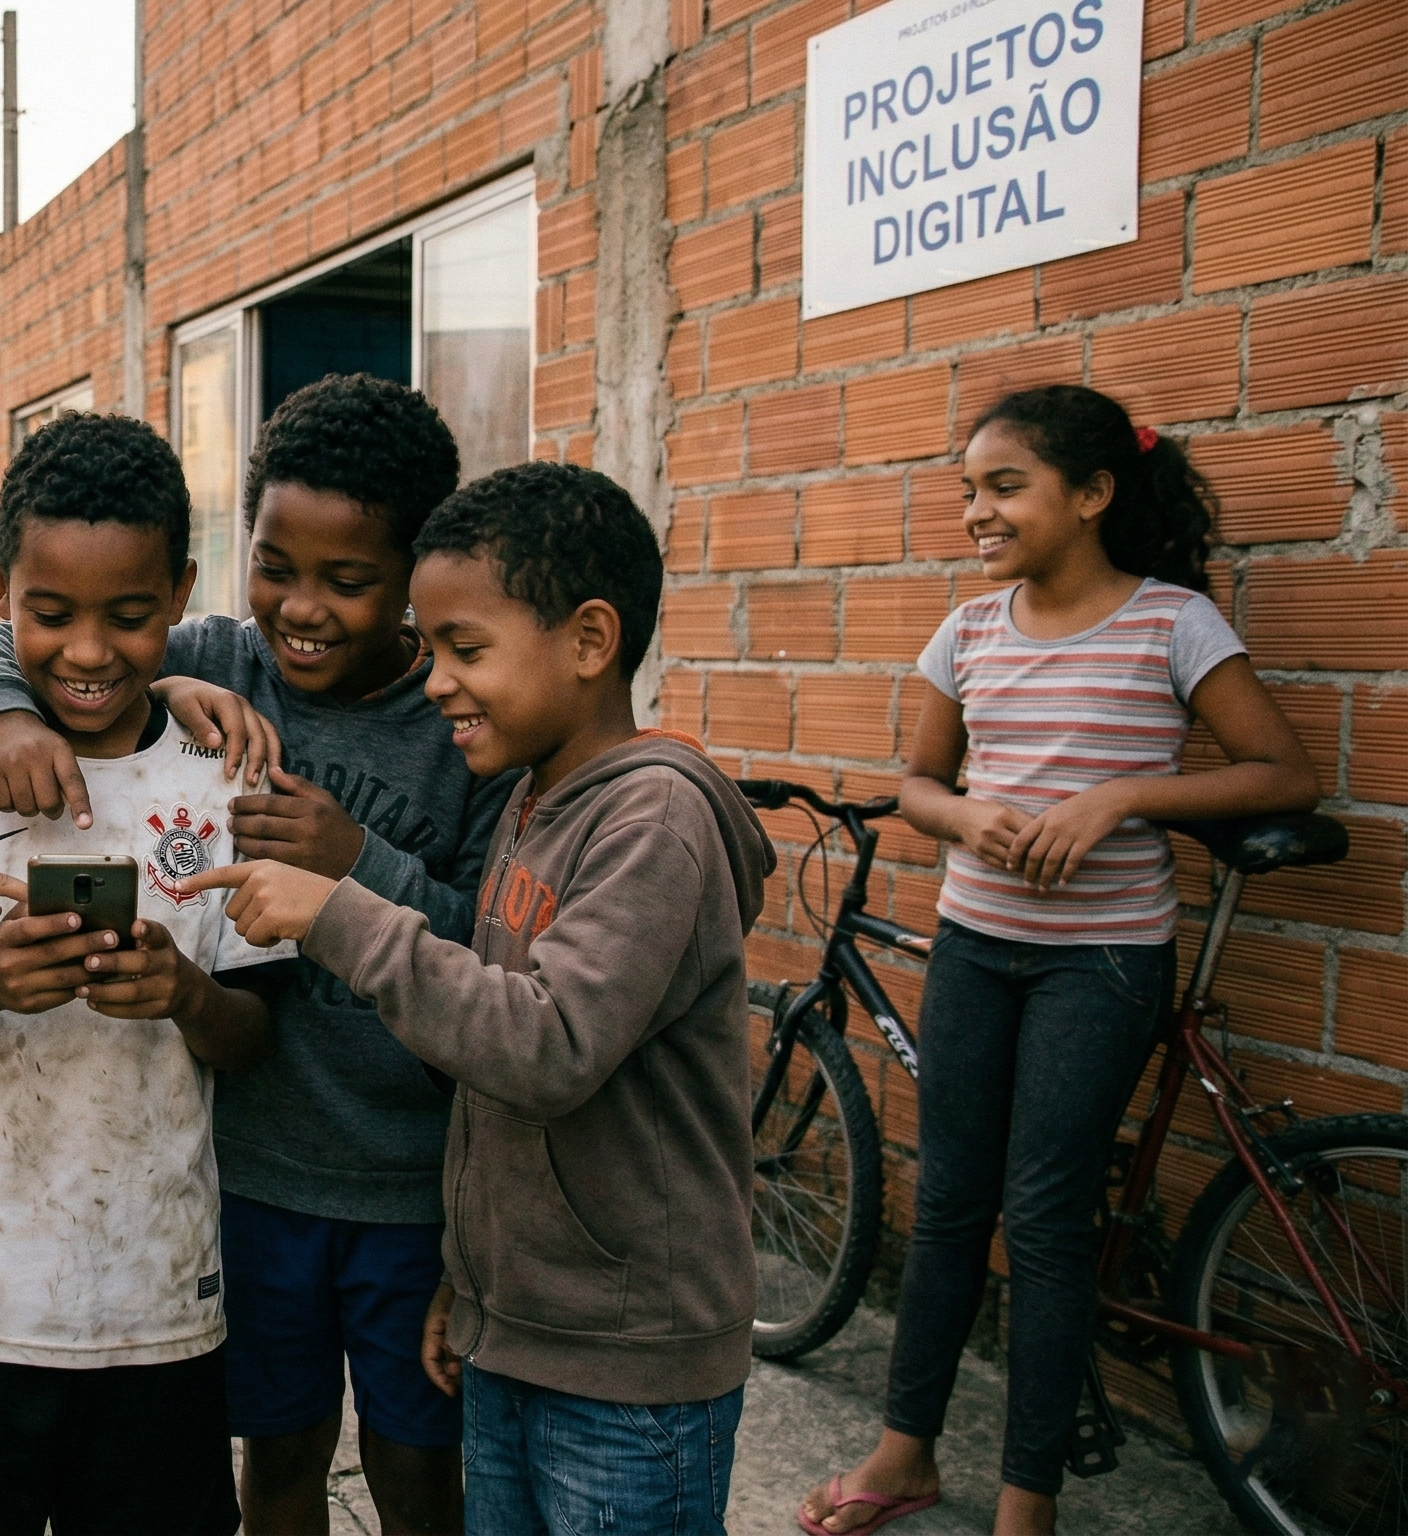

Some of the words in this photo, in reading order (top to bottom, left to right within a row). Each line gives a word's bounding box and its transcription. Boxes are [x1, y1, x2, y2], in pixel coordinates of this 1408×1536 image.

[844, 0, 1104, 140] PROJETOS
[848, 77, 1100, 206] INCLUSÃO
[873, 169, 1065, 265] DIGITAL
